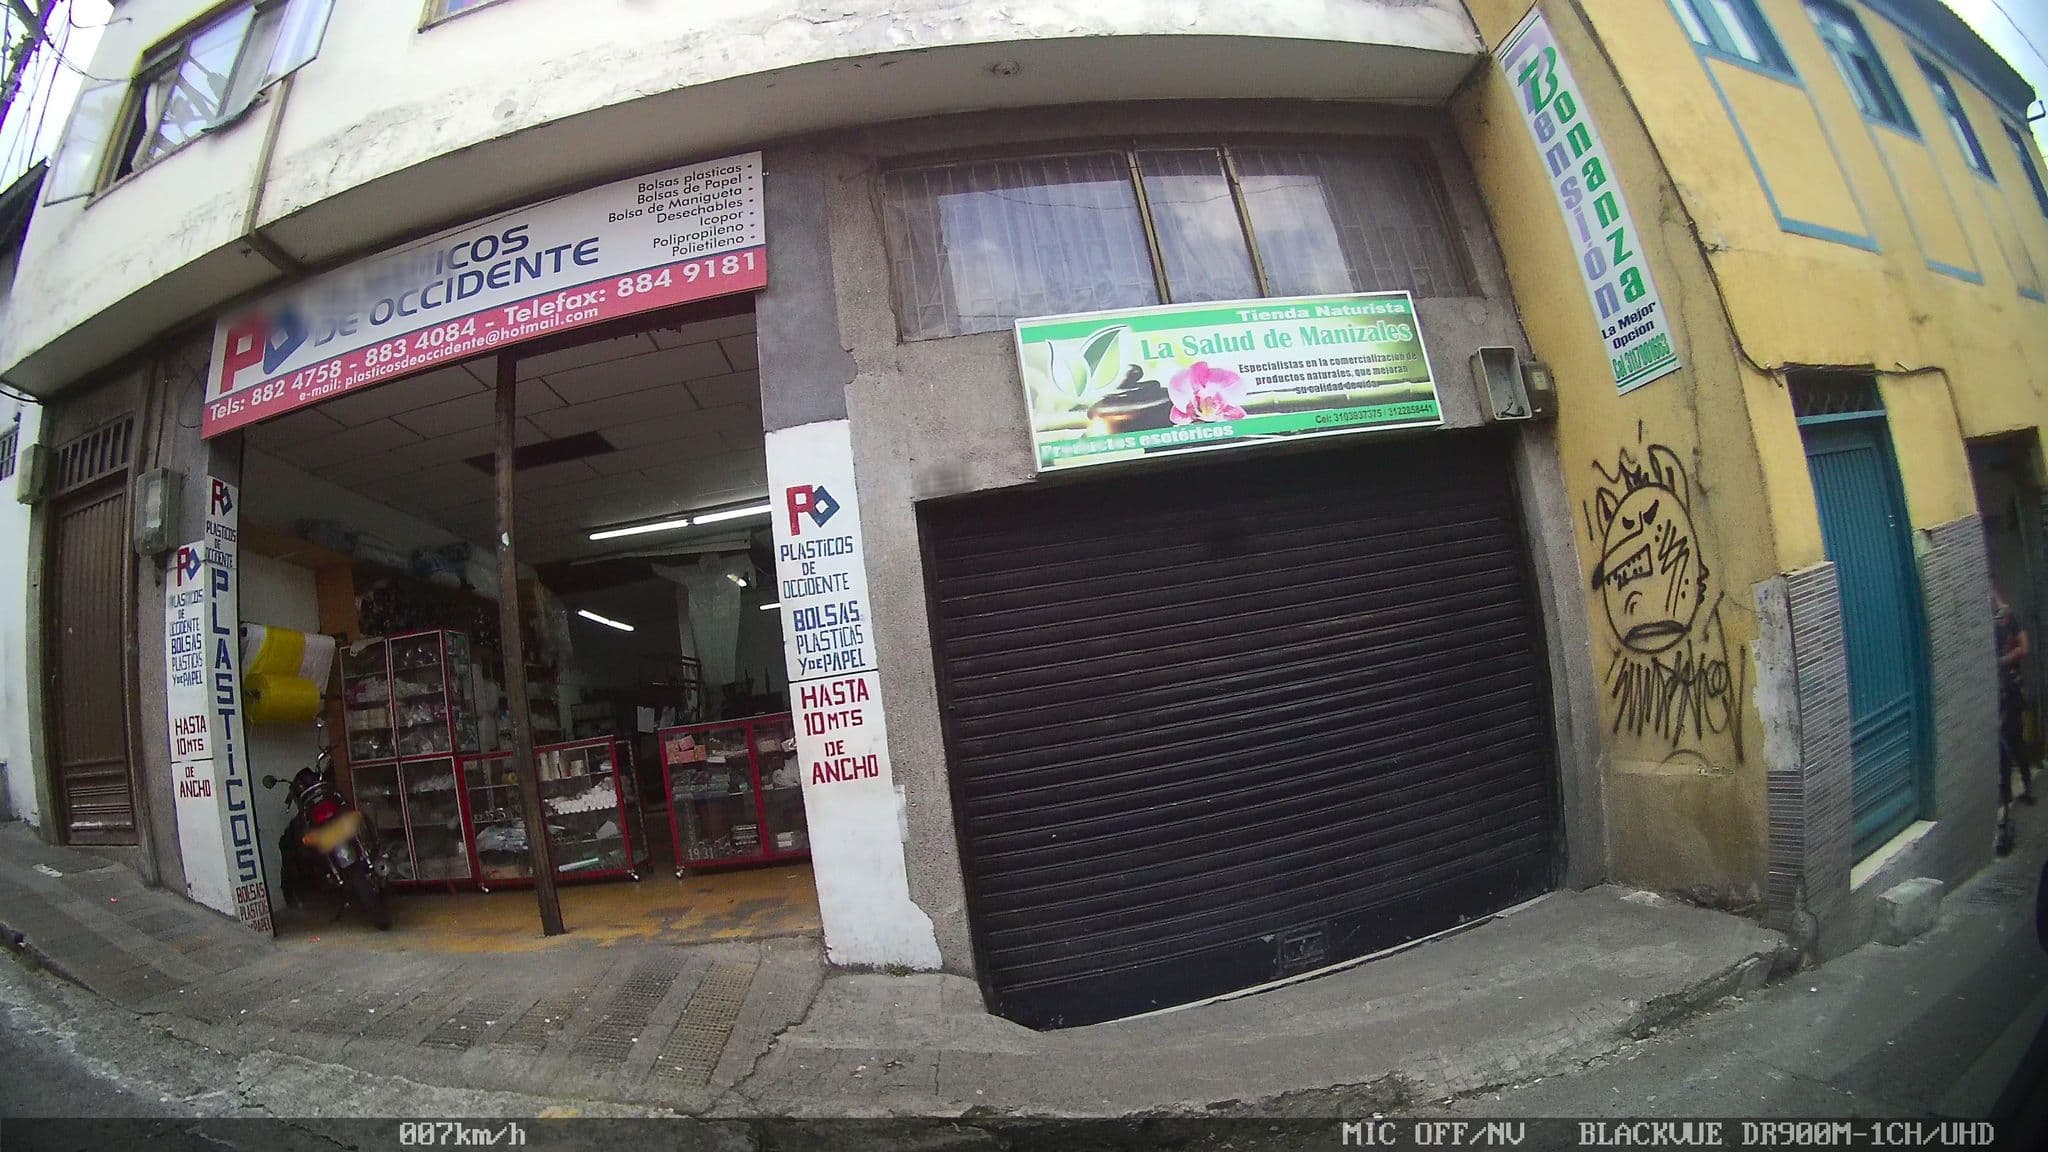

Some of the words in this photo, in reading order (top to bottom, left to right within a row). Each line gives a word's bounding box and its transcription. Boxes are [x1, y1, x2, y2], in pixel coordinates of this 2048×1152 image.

[638, 177, 679, 193] Bolsas
[638, 189, 679, 204] Bolsas
[683, 183, 700, 194] de
[705, 174, 742, 190] Papel
[608, 208, 643, 222] Bolsa
[647, 203, 664, 214] de
[669, 187, 742, 209] Manigueta
[657, 199, 743, 223] Desechables
[700, 211, 744, 226] Icopor
[653, 223, 744, 248] Polipropileno
[672, 235, 744, 256] Polietileno
[314, 317, 358, 347] DE
[370, 236, 600, 326] OCCIDENTE
[1236, 307, 1310, 322] Tienda
[1315, 302, 1405, 318] Naturista
[1601, 326, 1616, 339] La
[1618, 302, 1656, 330] Mejor
[210, 399, 245, 421] Tels:
[251, 380, 286, 406] 882
[291, 360, 342, 390] 4758
[365, 339, 407, 367] 883
[415, 318, 476, 350] 4084
[504, 287, 606, 325] Telefax:
[617, 268, 673, 297] 884
[682, 252, 756, 282] 9181
[1141, 338, 1174, 360] La
[1183, 330, 1255, 357] Salud
[1263, 327, 1293, 349] de
[1299, 320, 1413, 346] Manizales
[299, 381, 341, 401] e-mail:
[345, 307, 599, 389] plasticosdeoccidente@hotmail.com
[1239, 360, 1304, 373] Especialistas
[1305, 360, 1318, 368] en
[1319, 358, 1329, 367] la
[1407, 351, 1417, 361] de
[1255, 373, 1305, 386] productos
[1355, 368, 1371, 377] que
[1373, 365, 1409, 376] mejoran
[1140, 424, 1234, 446] esotéricos
[214, 539, 221, 550] DE
[802, 561, 816, 576] DE
[178, 608, 185, 620] DE
[793, 600, 860, 632] BOLSAS
[171, 633, 202, 655] BOLSAS
[800, 678, 870, 710] HASTA
[175, 715, 207, 735] HASTA
[824, 740, 845, 757] DE
[185, 766, 195, 778] DE
[812, 754, 879, 785] ANCHO
[180, 779, 212, 799] ANCHO
